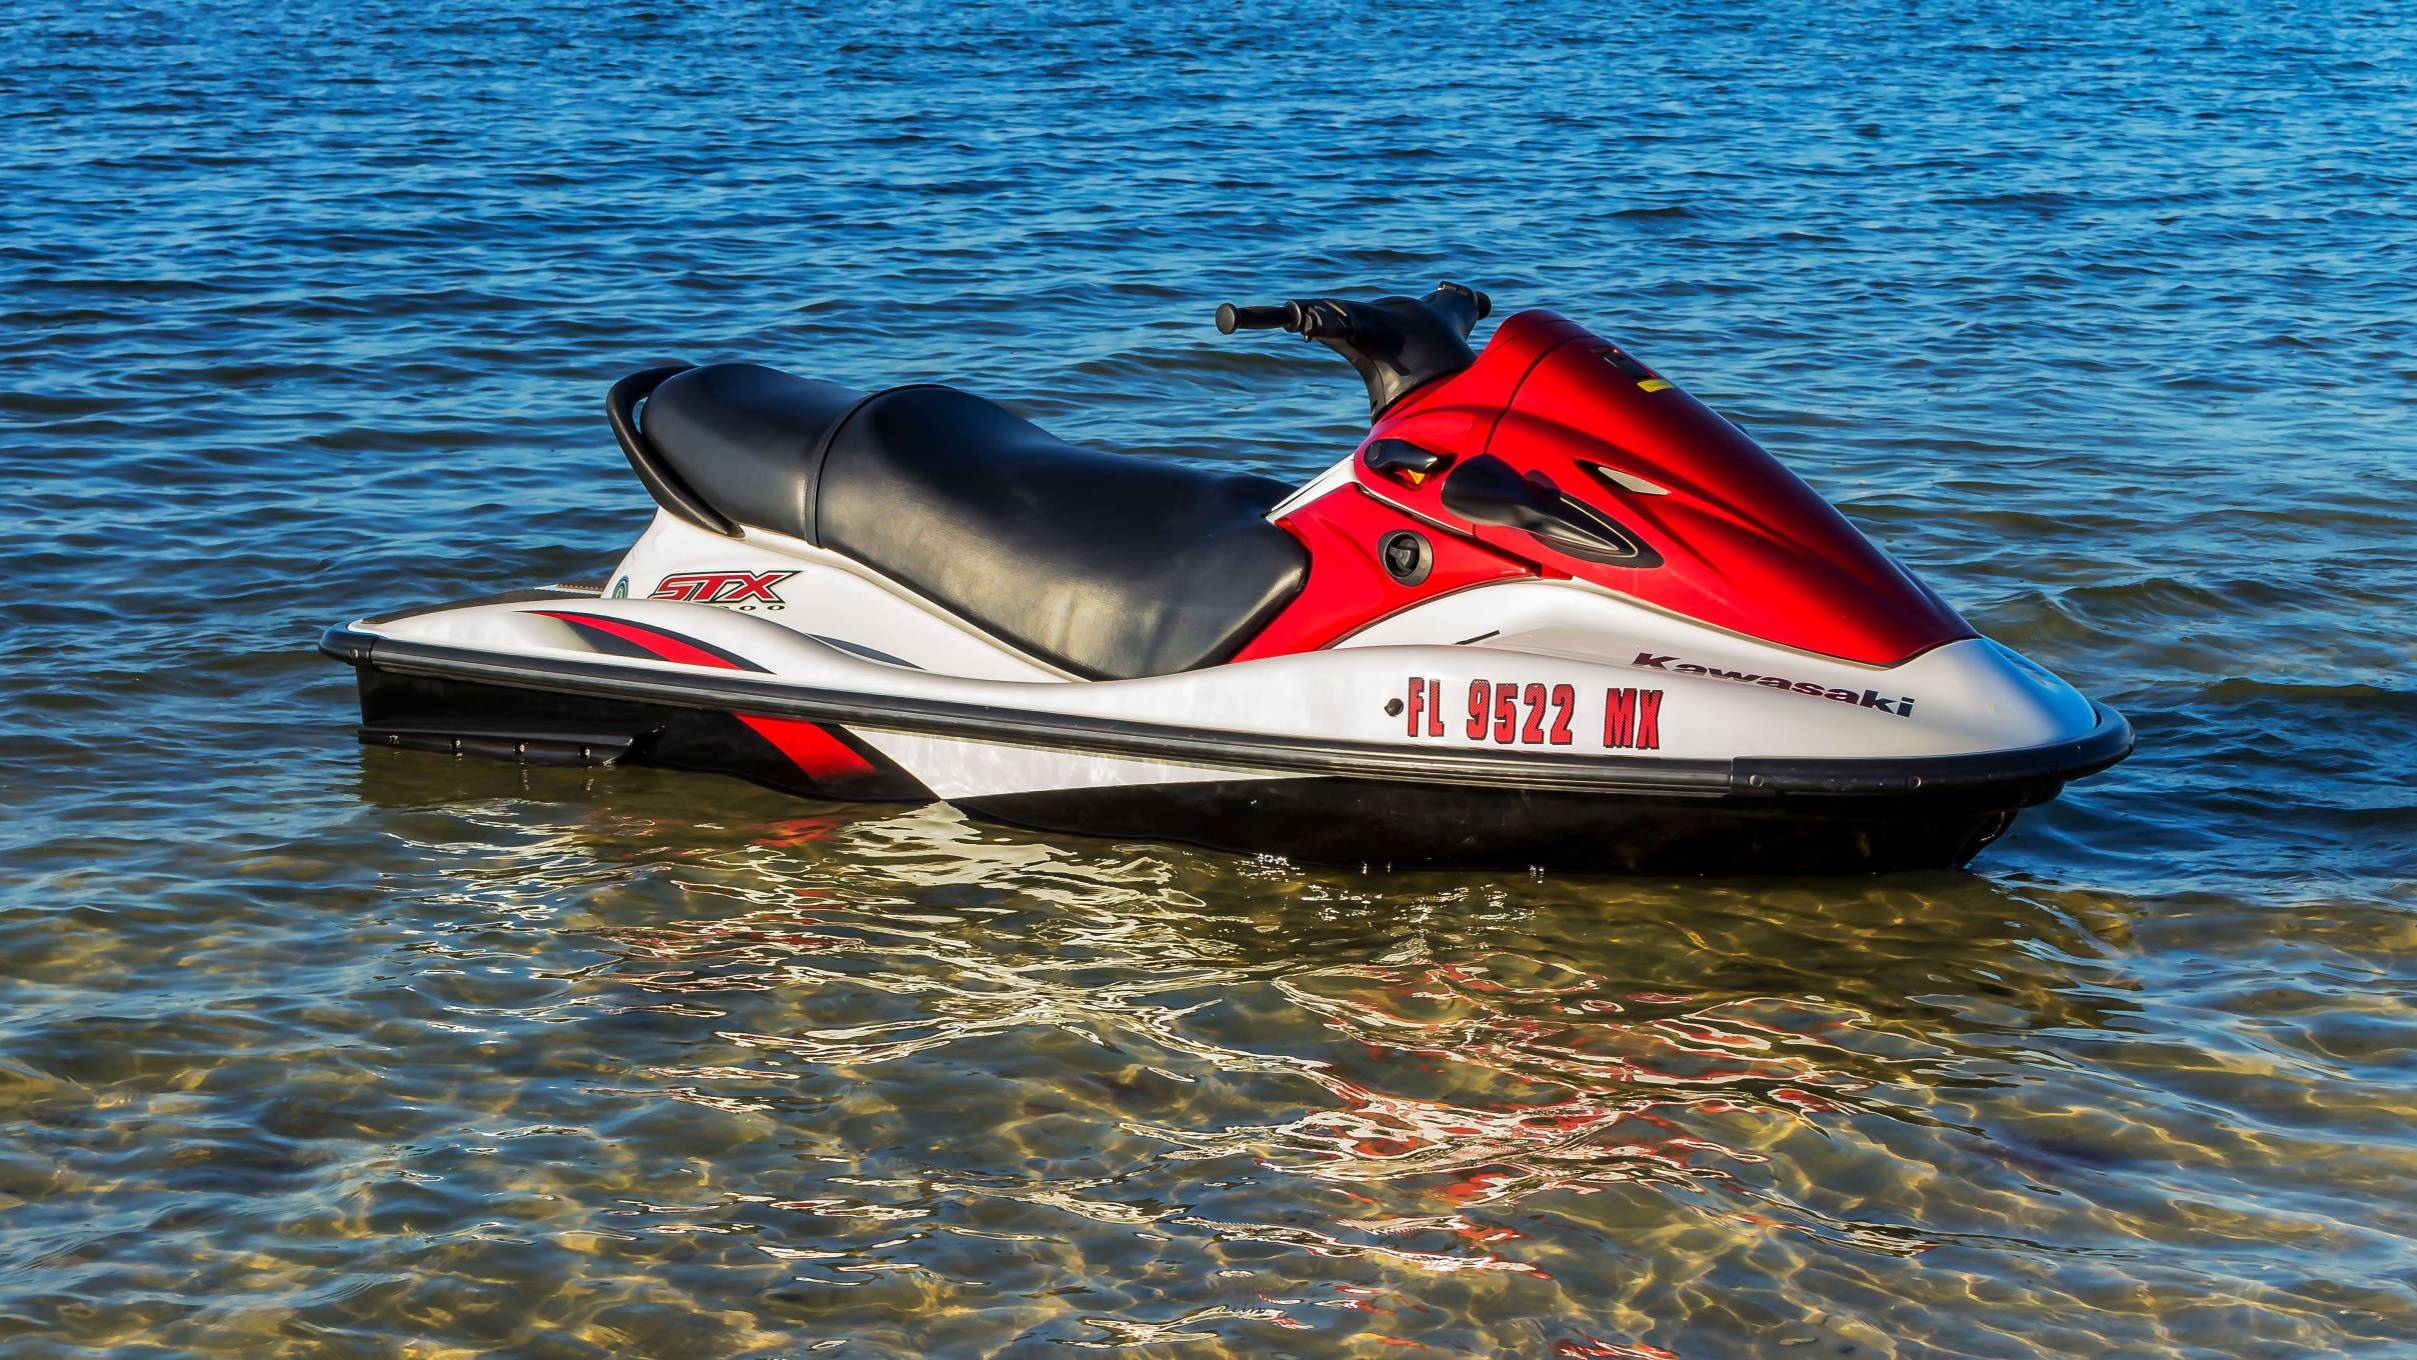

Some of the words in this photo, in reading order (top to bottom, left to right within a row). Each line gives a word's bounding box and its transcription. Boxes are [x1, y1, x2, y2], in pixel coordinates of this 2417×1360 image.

[647, 570, 803, 603] STX
[1407, 677, 1445, 737] FL
[1466, 679, 1576, 745] 9522
[1603, 688, 1664, 749] MX
[1631, 652, 1915, 718] Kawasaki
